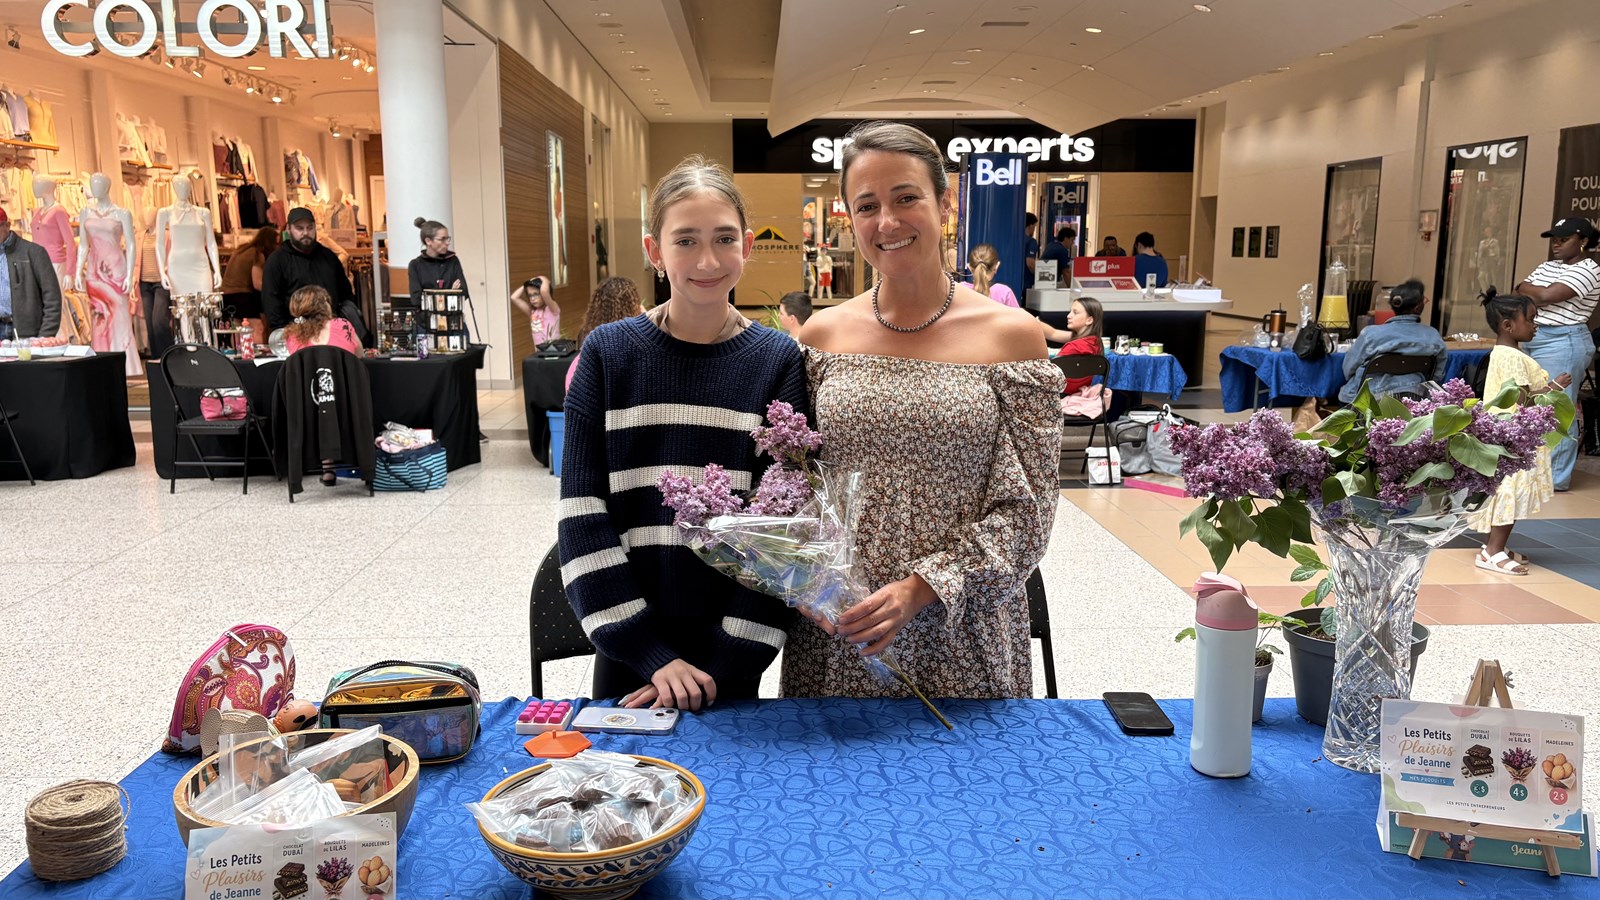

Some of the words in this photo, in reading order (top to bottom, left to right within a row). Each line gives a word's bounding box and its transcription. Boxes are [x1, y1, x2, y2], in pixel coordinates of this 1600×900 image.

[41, 0, 330, 58] COLORI
[976, 158, 1022, 186] Bell
[1573, 175, 1600, 191] TOU
[1053, 185, 1085, 204] Bell
[1404, 727, 1420, 738] Les
[1423, 728, 1452, 741] Petits
[1399, 740, 1456, 756] Plaisirs
[1404, 756, 1415, 765] de
[1417, 756, 1451, 769] Jeanne
[361, 840, 390, 848] MADELEINES
[1511, 844, 1543, 856] Jean
[282, 848, 304, 857] DUBAÏ
[210, 856, 228, 869] Les
[231, 853, 263, 867] Petits
[202, 868, 267, 894] Plaisirs
[209, 890, 222, 900] de
[224, 887, 262, 900] Jeanne
